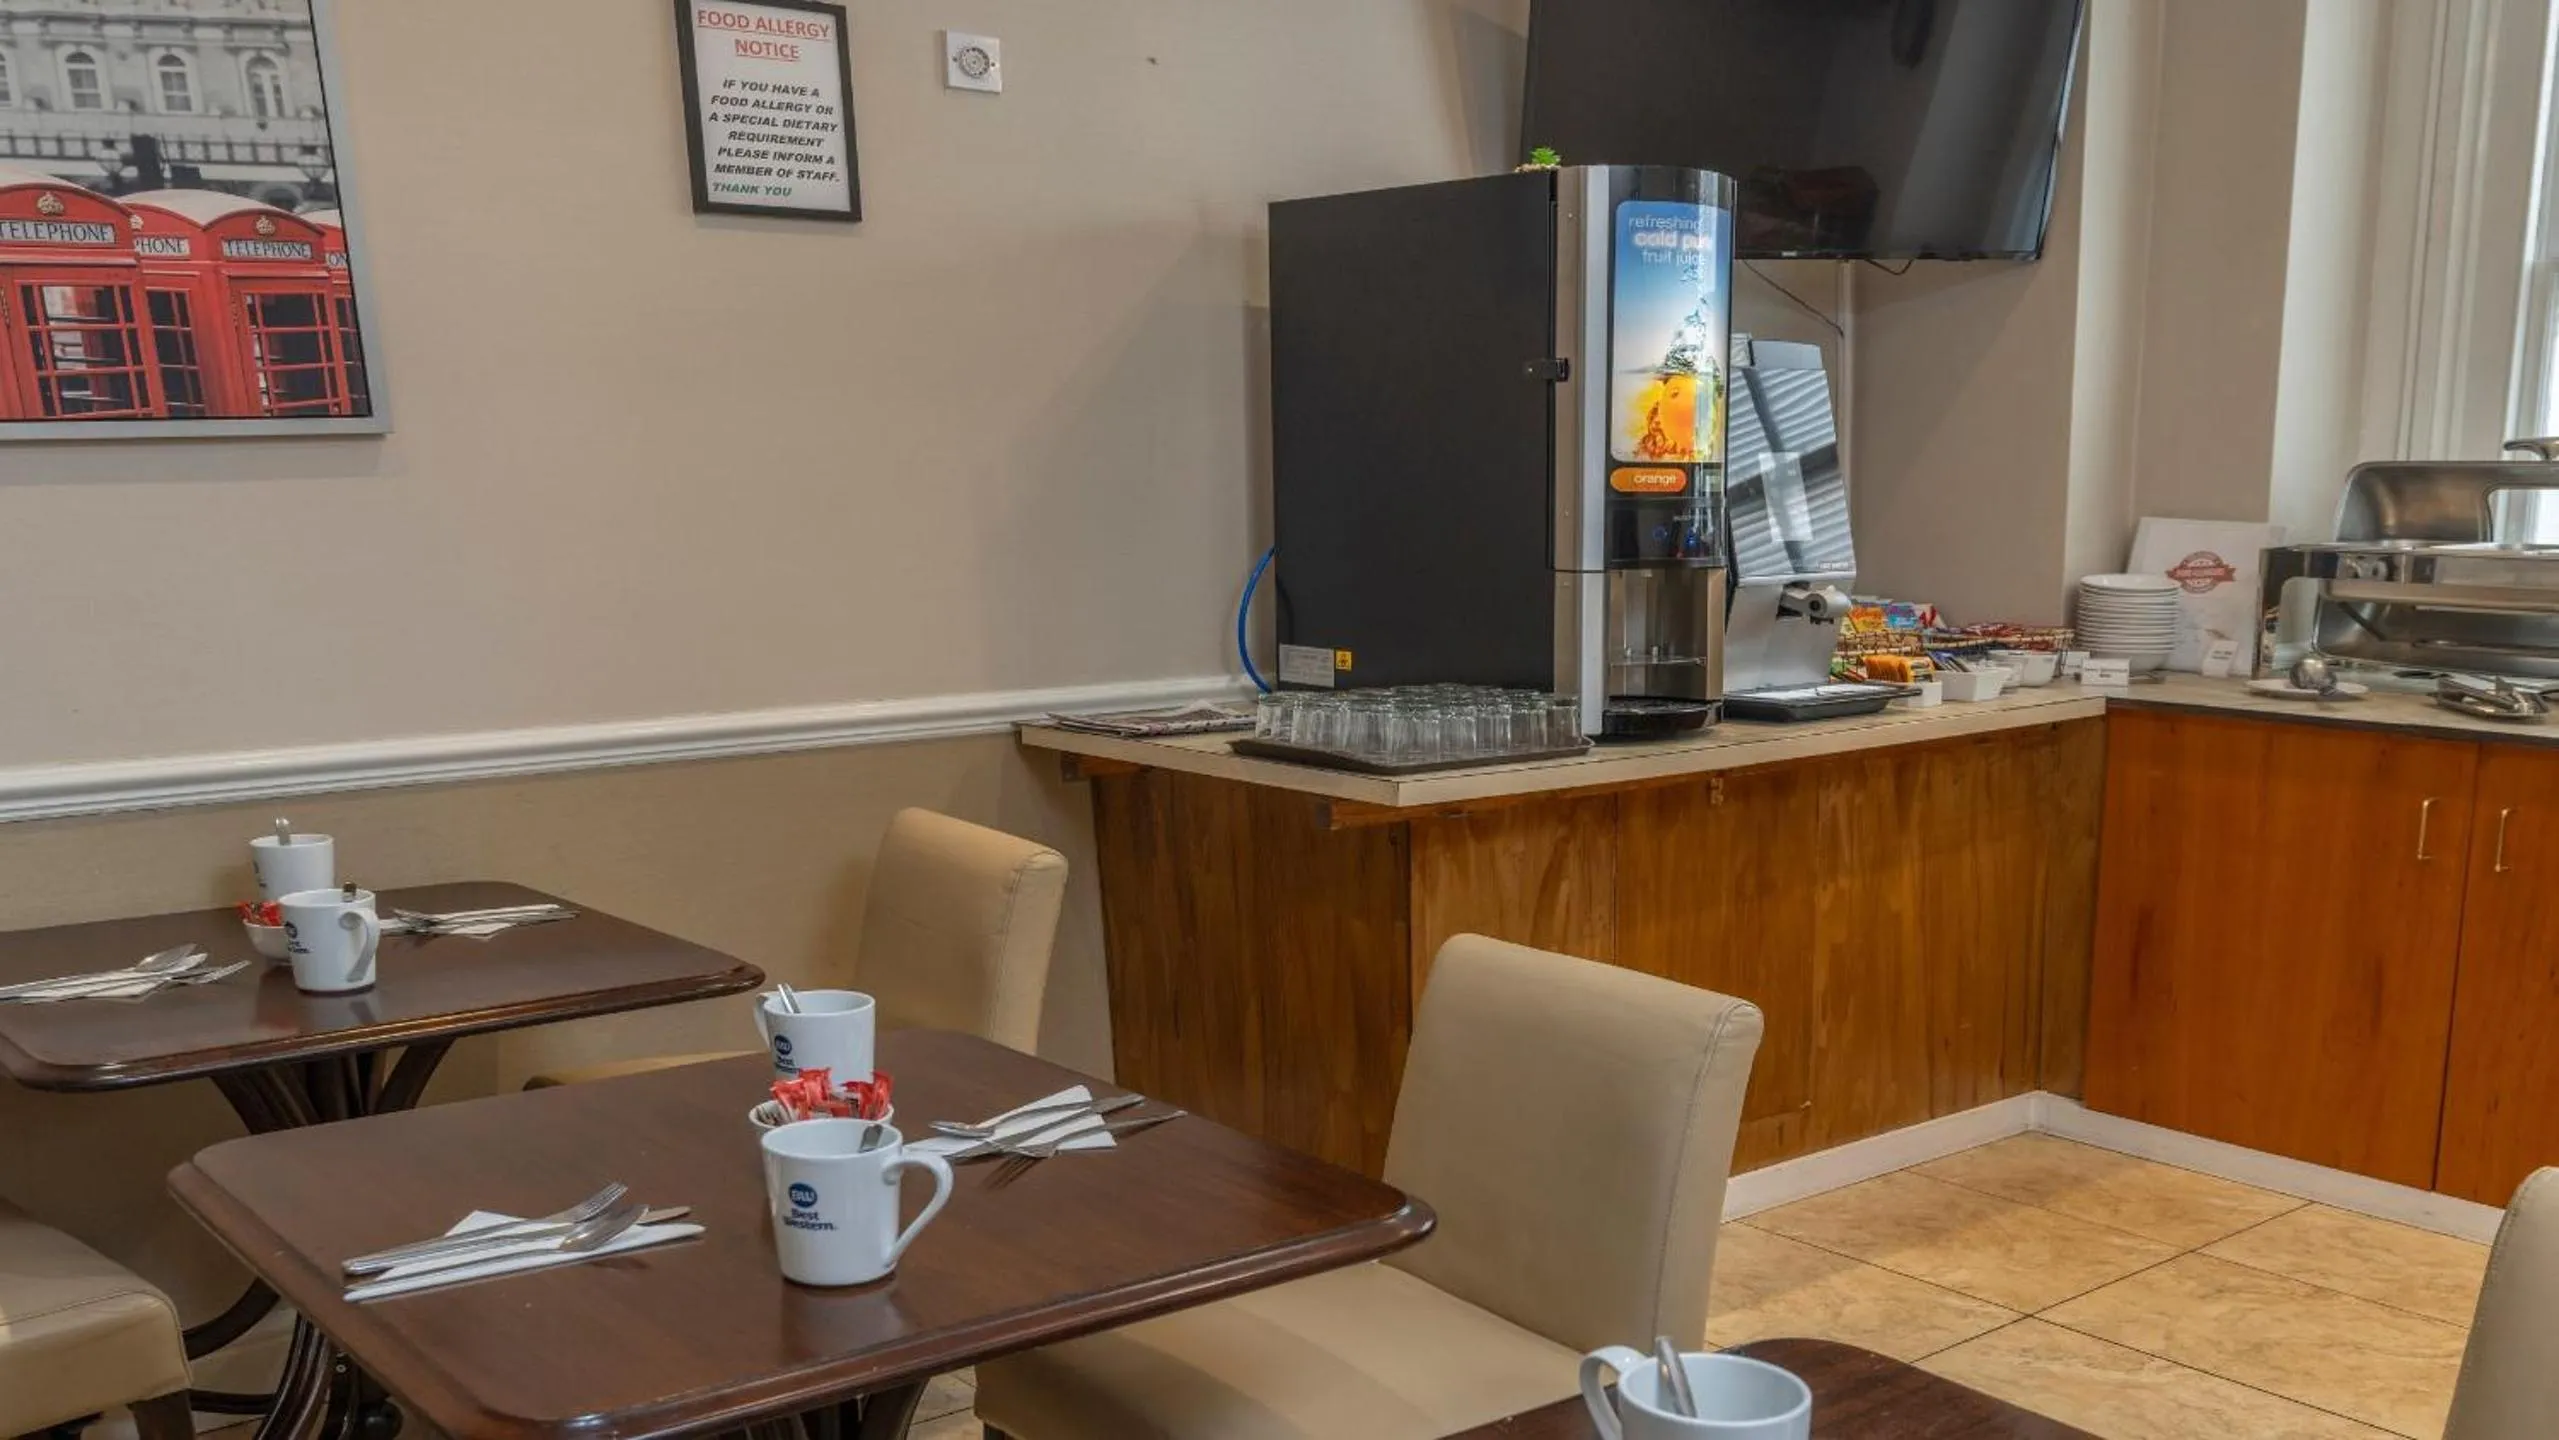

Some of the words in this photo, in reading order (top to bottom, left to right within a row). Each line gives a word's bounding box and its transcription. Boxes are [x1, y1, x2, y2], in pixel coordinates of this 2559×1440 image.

[697, 10, 750, 28] FOOD
[755, 15, 830, 38] ALLERGY
[735, 39, 800, 59] NOTICE
[723, 79, 736, 88] IF
[740, 81, 768, 92] YOU
[772, 84, 807, 96] HAVE
[811, 88, 820, 97] A
[711, 95, 749, 106] FOOD
[752, 100, 813, 113] ALLERGY
[816, 106, 834, 115] OR
[709, 112, 719, 122] A
[722, 114, 778, 127] SPECIAL
[783, 119, 838, 132] DIETARY
[728, 131, 825, 147] REQUIREMENT
[718, 147, 769, 160] PLEASE
[773, 152, 823, 164] INFORM
[826, 156, 835, 165] A
[714, 164, 773, 176] MEMBER
[776, 169, 794, 178] OF
[797, 170, 840, 182] STAFF.
[713, 182, 759, 194] THANK
[765, 187, 793, 197] YOU
[1634, 230, 1678, 248] cold
[228, 240, 311, 259] TELEPHONE
[1642, 248, 1672, 264] fruit
[1633, 474, 1676, 487] orange
[791, 1208, 819, 1220] Best
